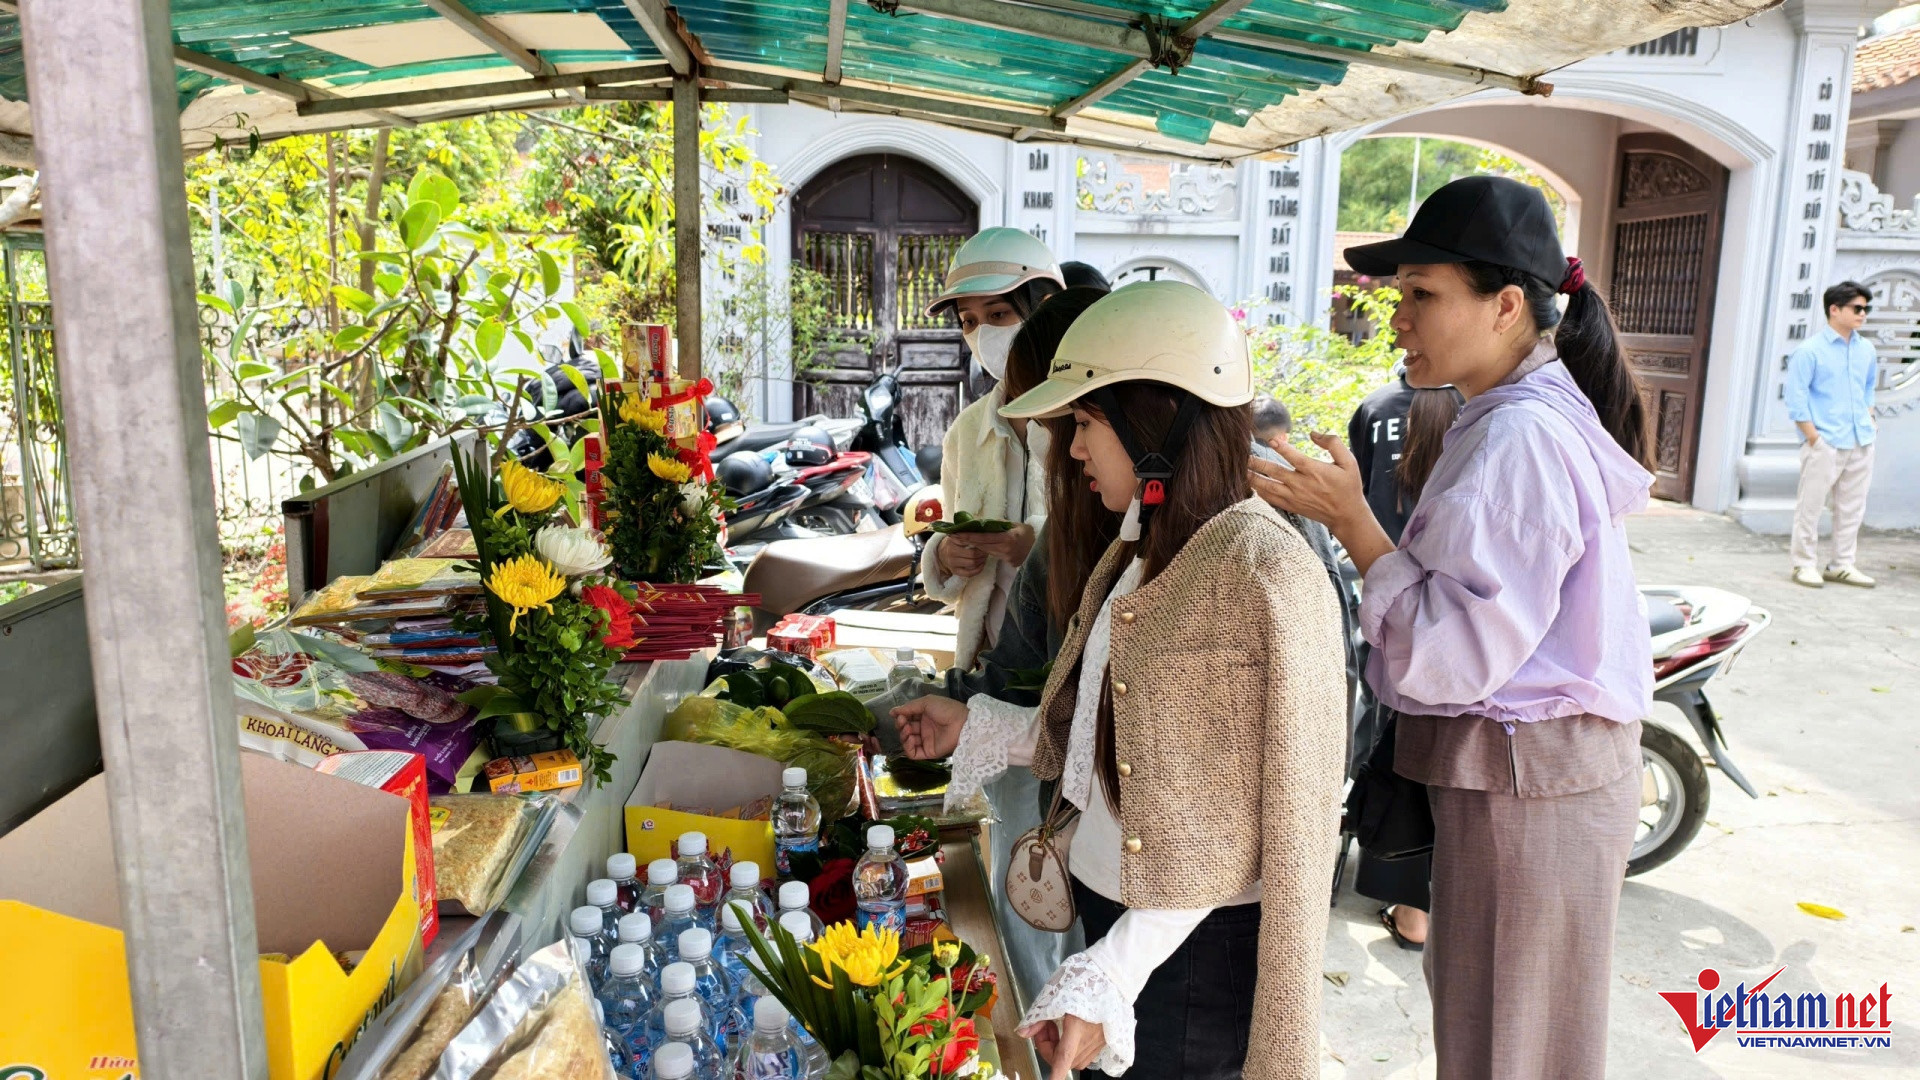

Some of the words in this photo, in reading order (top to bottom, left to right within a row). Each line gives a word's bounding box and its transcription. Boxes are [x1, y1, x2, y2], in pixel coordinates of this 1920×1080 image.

[1812, 113, 1832, 131] HOA
[1029, 148, 1049, 170] DÂN
[1023, 191, 1053, 209] KHANG
[1803, 198, 1821, 219] GIÓ
[1271, 222, 1291, 245] BÁT
[1269, 252, 1290, 273] NHÃ
[1798, 262, 1811, 280] BI
[246, 717, 293, 739] KHOAI
[293, 730, 332, 756] LANG
